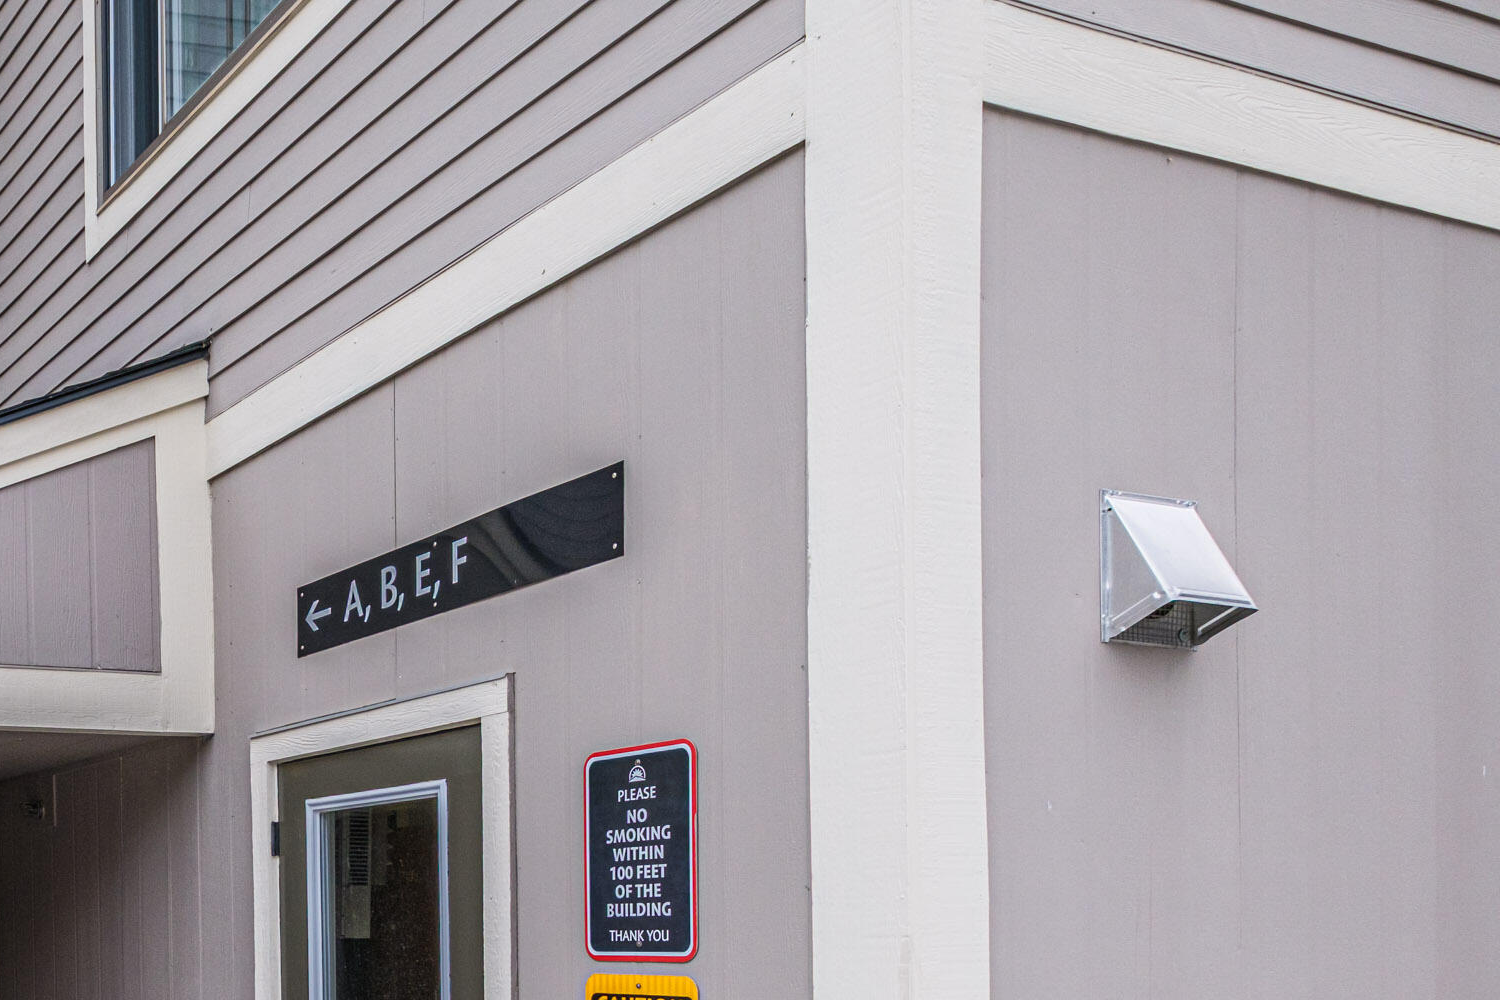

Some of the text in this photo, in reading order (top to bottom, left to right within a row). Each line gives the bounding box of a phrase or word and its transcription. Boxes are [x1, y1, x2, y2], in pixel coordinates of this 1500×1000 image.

[343, 536, 467, 622] A, B, E, F
[617, 786, 657, 802] PLEASE
[626, 808, 647, 824] NO
[606, 825, 671, 844] SMOKING
[613, 845, 664, 862] WITHIN
[610, 864, 667, 881] 100 FEET
[615, 883, 661, 899] OF THE
[606, 902, 672, 918] BUILDING
[609, 930, 669, 941] THANK YOU
